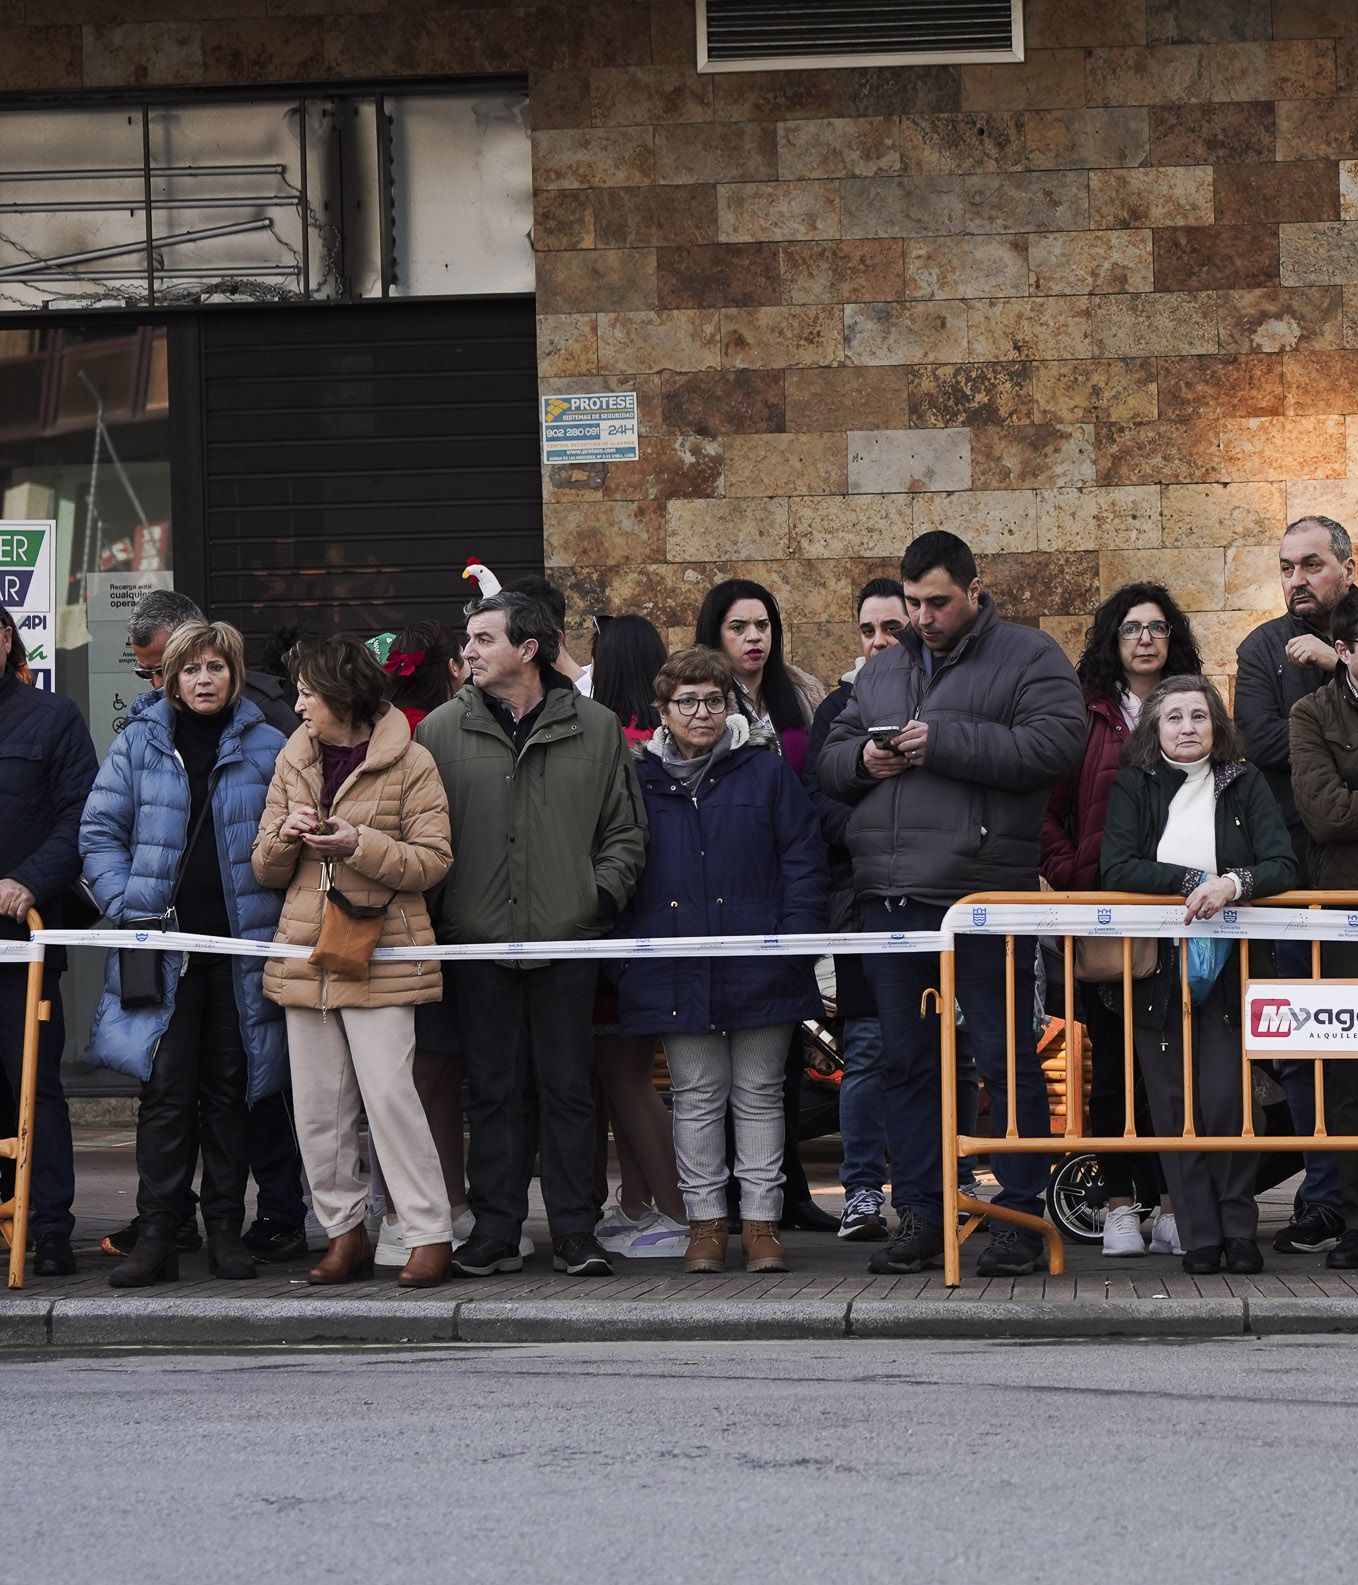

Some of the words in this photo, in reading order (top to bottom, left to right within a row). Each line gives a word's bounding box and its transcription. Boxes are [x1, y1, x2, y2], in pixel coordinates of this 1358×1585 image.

[570, 396, 634, 410] PROTESE
[562, 413, 591, 421] SISTEMAS
[600, 411, 634, 419] SEGURIDAD
[546, 429, 564, 438] 902
[566, 428, 584, 437] 280
[585, 427, 600, 436] 091
[608, 423, 635, 436] 24H
[110, 584, 137, 592] Recarga
[18, 614, 47, 631] API
